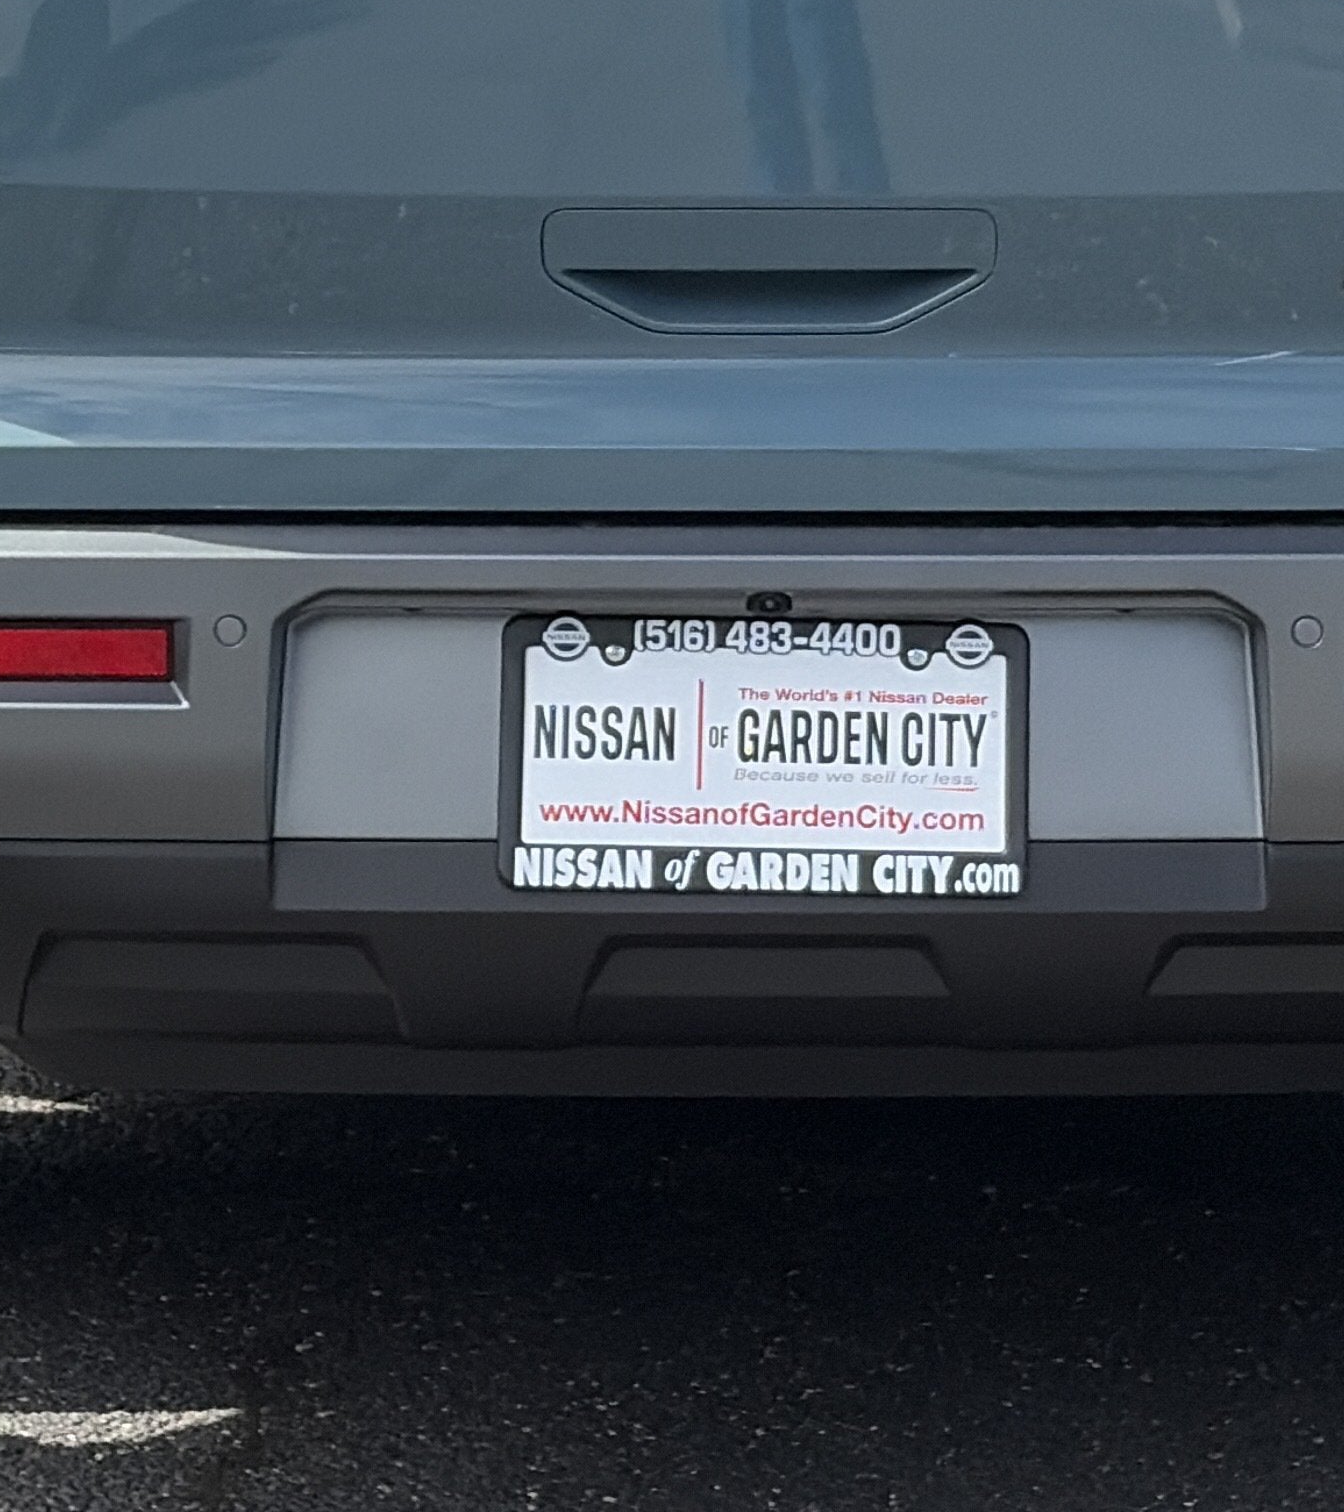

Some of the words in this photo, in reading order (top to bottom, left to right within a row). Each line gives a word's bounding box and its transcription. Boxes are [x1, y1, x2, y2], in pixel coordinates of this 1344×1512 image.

[634, 619, 716, 652] (516)
[725, 621, 901, 657] 483-4400
[739, 688, 769, 701] The
[775, 688, 838, 703] World's
[844, 690, 862, 702] #1
[869, 691, 927, 705] Nissan
[932, 692, 989, 706] Dealer
[533, 704, 676, 761] NISSAN
[709, 726, 729, 748] OF
[737, 708, 888, 765] GARDEN
[902, 711, 988, 768] CITY
[734, 768, 819, 782] Because
[826, 772, 854, 783] we
[862, 771, 897, 784] sell
[901, 771, 928, 785] for
[933, 772, 978, 786] less.
[540, 800, 985, 834] www.NissanofGardenCity.com
[513, 847, 653, 889] NISSAN
[664, 849, 701, 891] of
[706, 850, 860, 892] GARDEN
[872, 854, 1020, 894] CITY.com
